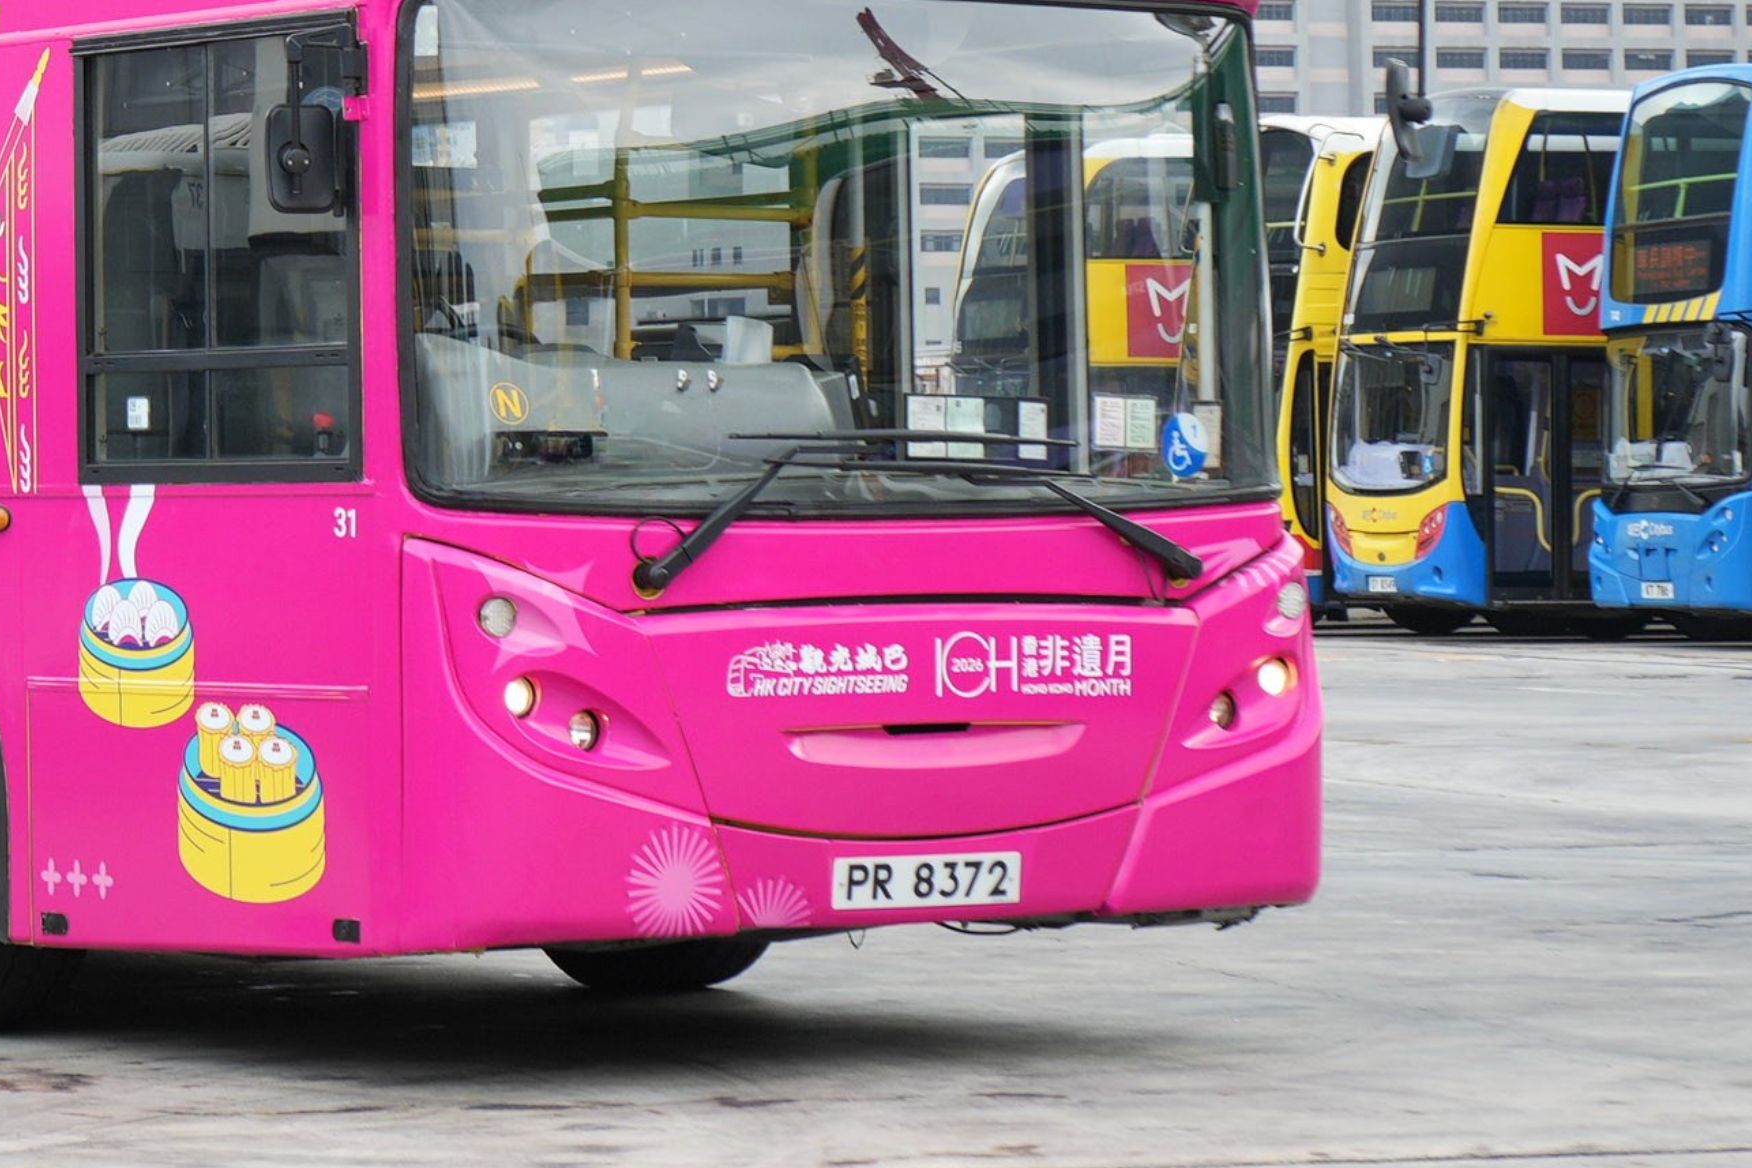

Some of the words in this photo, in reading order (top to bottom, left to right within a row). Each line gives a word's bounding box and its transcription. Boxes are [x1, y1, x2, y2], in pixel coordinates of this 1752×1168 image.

[333, 507, 357, 538] 31
[934, 630, 1018, 698] ICH
[951, 657, 985, 673] 2026
[1038, 633, 1132, 677] 非遺月
[753, 677, 776, 697] HK
[776, 676, 812, 696] CITY
[812, 673, 909, 695] SIGHTSEEING
[1074, 678, 1132, 697] MONTH
[846, 863, 893, 901] PR
[913, 859, 1008, 899] 8372
